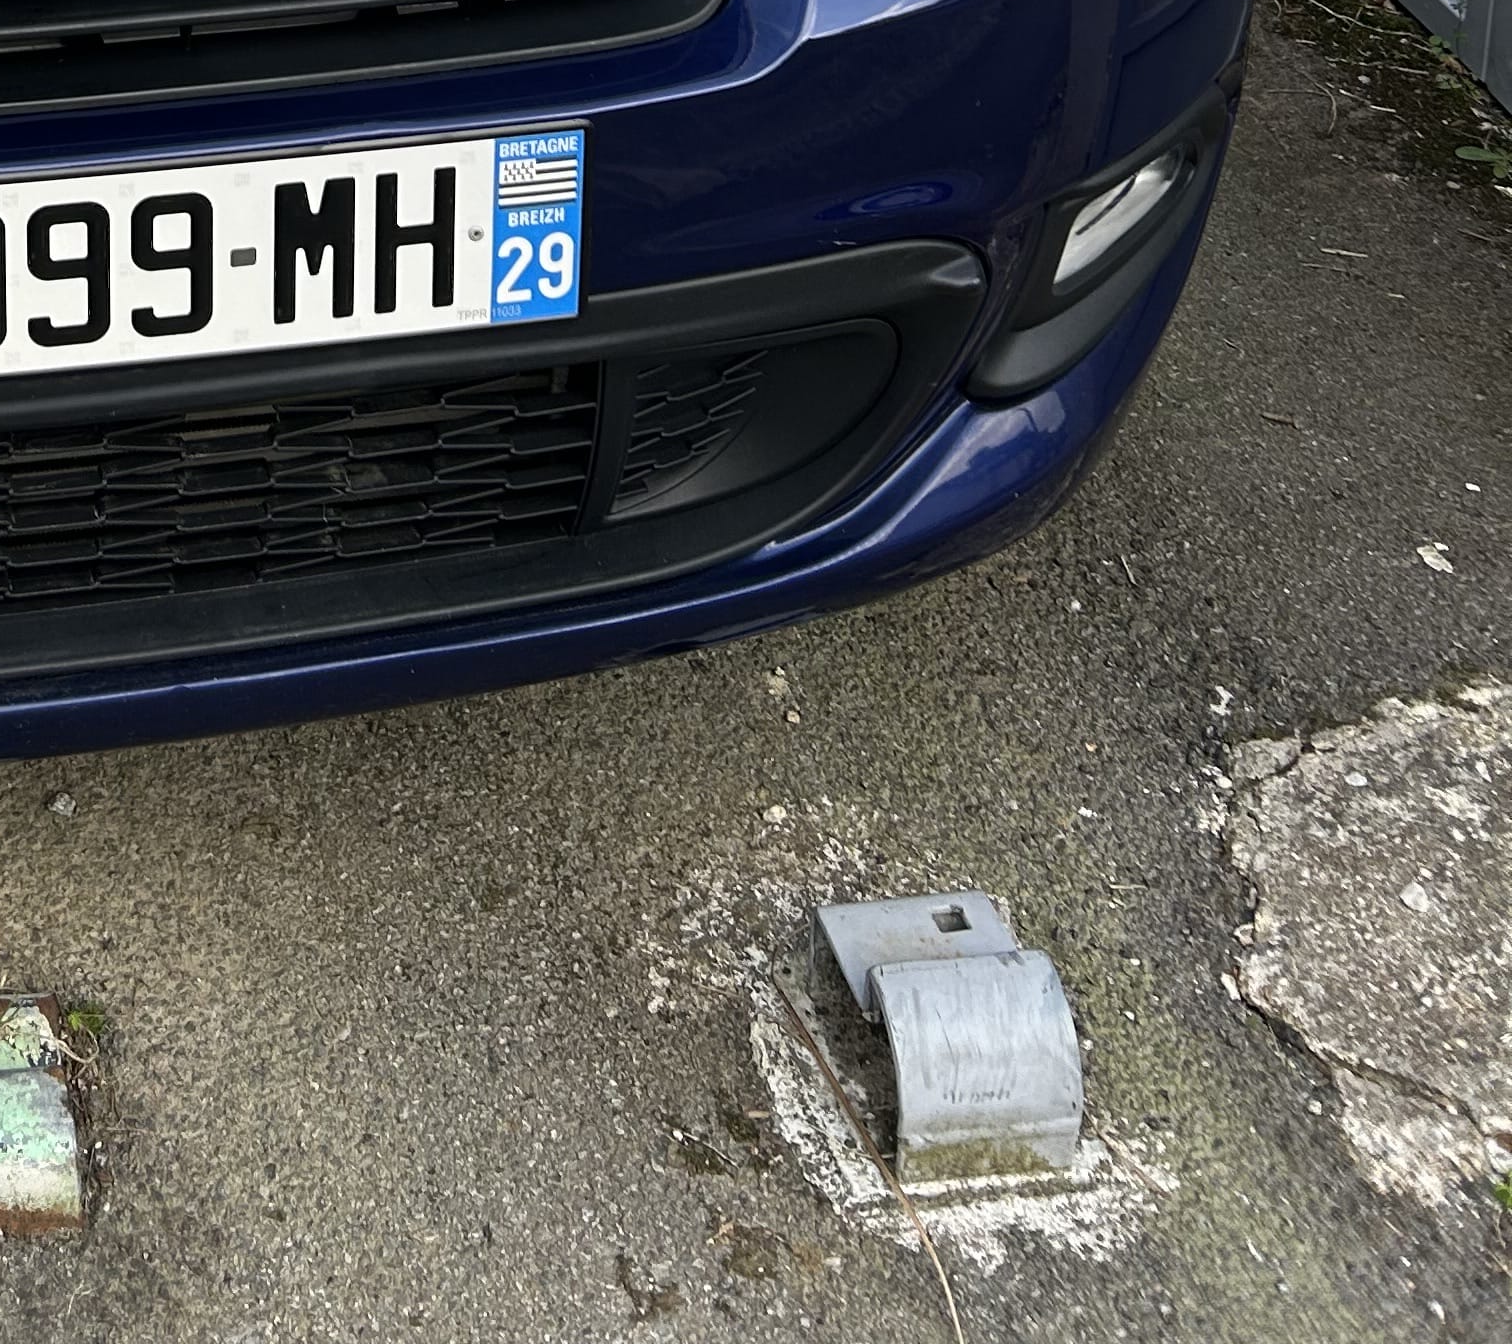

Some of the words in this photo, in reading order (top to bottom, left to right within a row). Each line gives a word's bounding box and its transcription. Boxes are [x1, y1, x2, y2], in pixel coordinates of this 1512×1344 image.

[499, 135, 579, 158] BRETAGNE
[508, 207, 565, 228] BREIZH
[496, 231, 575, 304] 29
